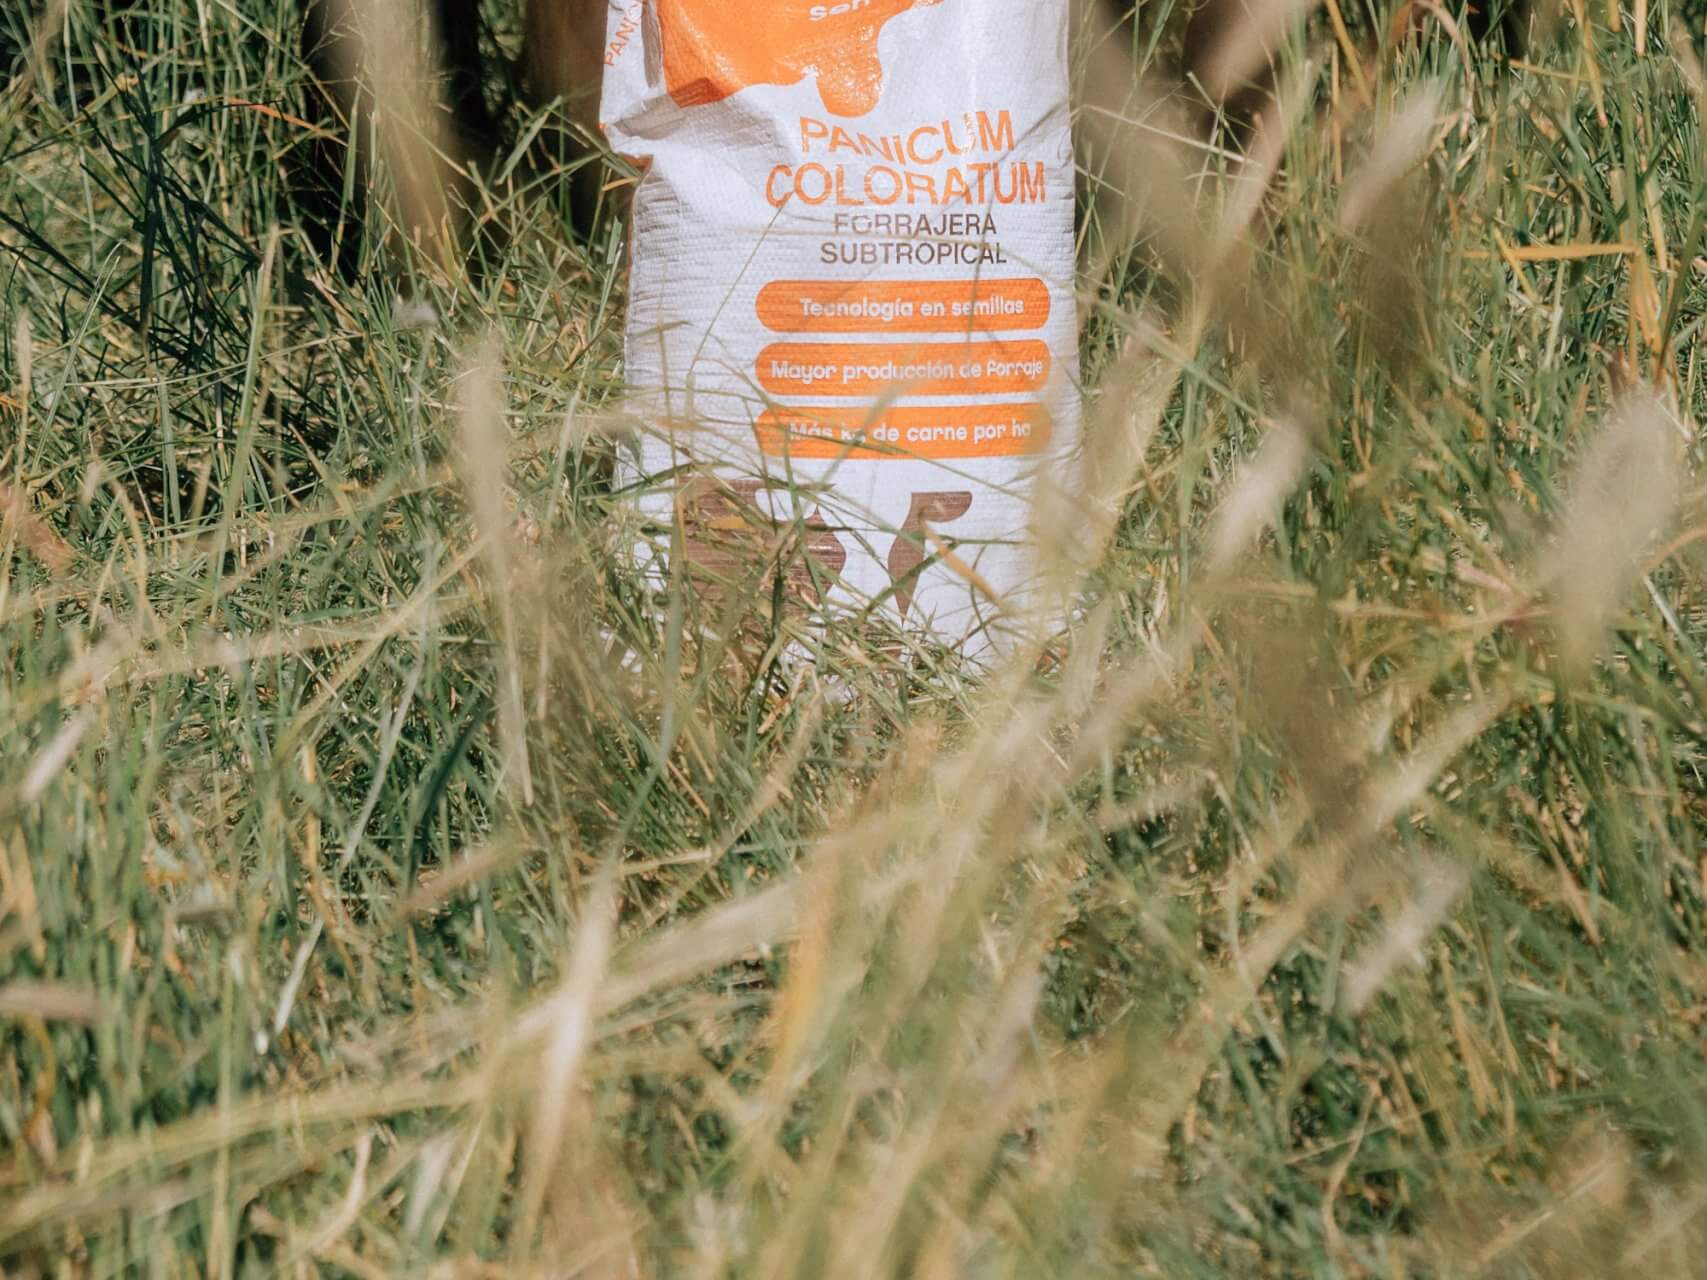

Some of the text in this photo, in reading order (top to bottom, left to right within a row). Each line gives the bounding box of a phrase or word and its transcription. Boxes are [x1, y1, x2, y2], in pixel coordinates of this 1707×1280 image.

[799, 109, 1014, 166] PANICUM
[764, 160, 1047, 208] COLORATUM
[832, 213, 997, 236] FORRAJERA
[819, 242, 1007, 266] SUBTROPICAL
[800, 296, 1025, 322] Tecnología en semillas
[771, 355, 1042, 385] Mayor producción de forraje
[872, 423, 899, 442] de
[906, 426, 968, 442] carne
[974, 423, 1007, 445] por
